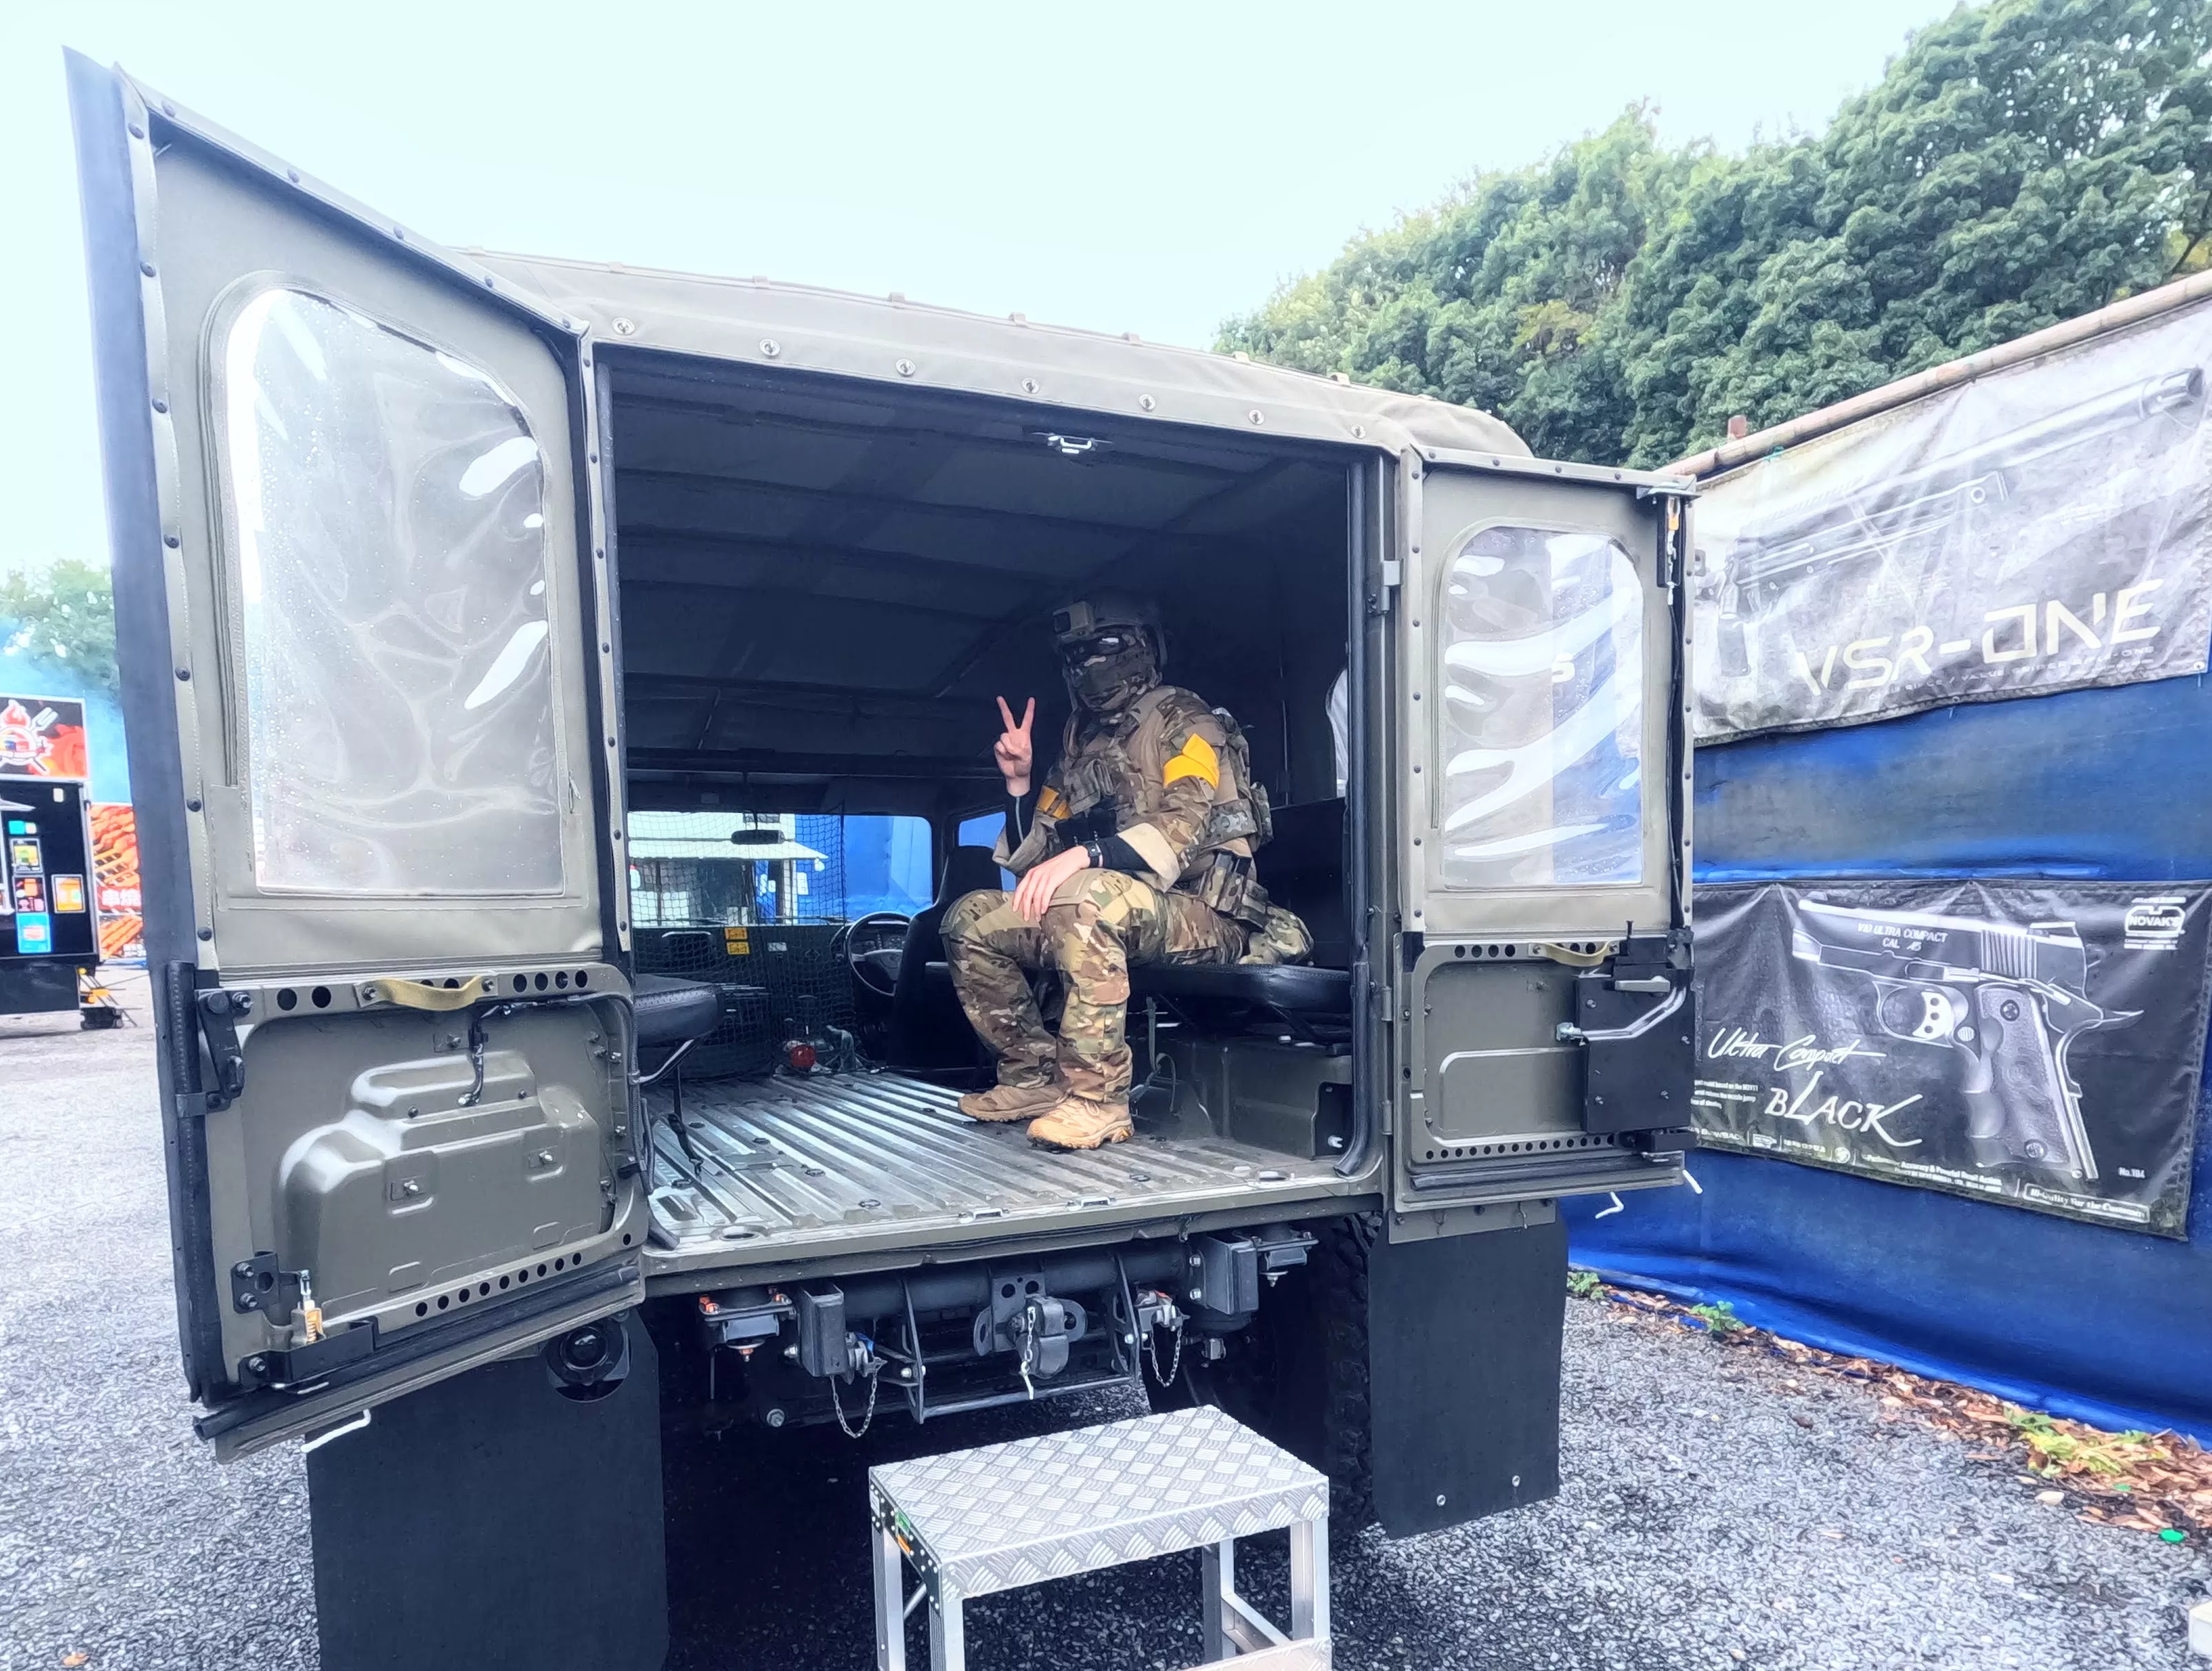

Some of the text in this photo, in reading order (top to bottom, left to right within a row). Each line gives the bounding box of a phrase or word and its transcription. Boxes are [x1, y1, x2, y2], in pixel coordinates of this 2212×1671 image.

[1795, 579, 2165, 695] VSR-ONE
[1873, 925, 1901, 937] ULTRA
[1904, 928, 1948, 943] COMPACT
[1708, 1027, 1886, 1071] Ultra Compact
[1765, 1071, 1923, 1147] BLACK
[2087, 1200, 2102, 1209] the
